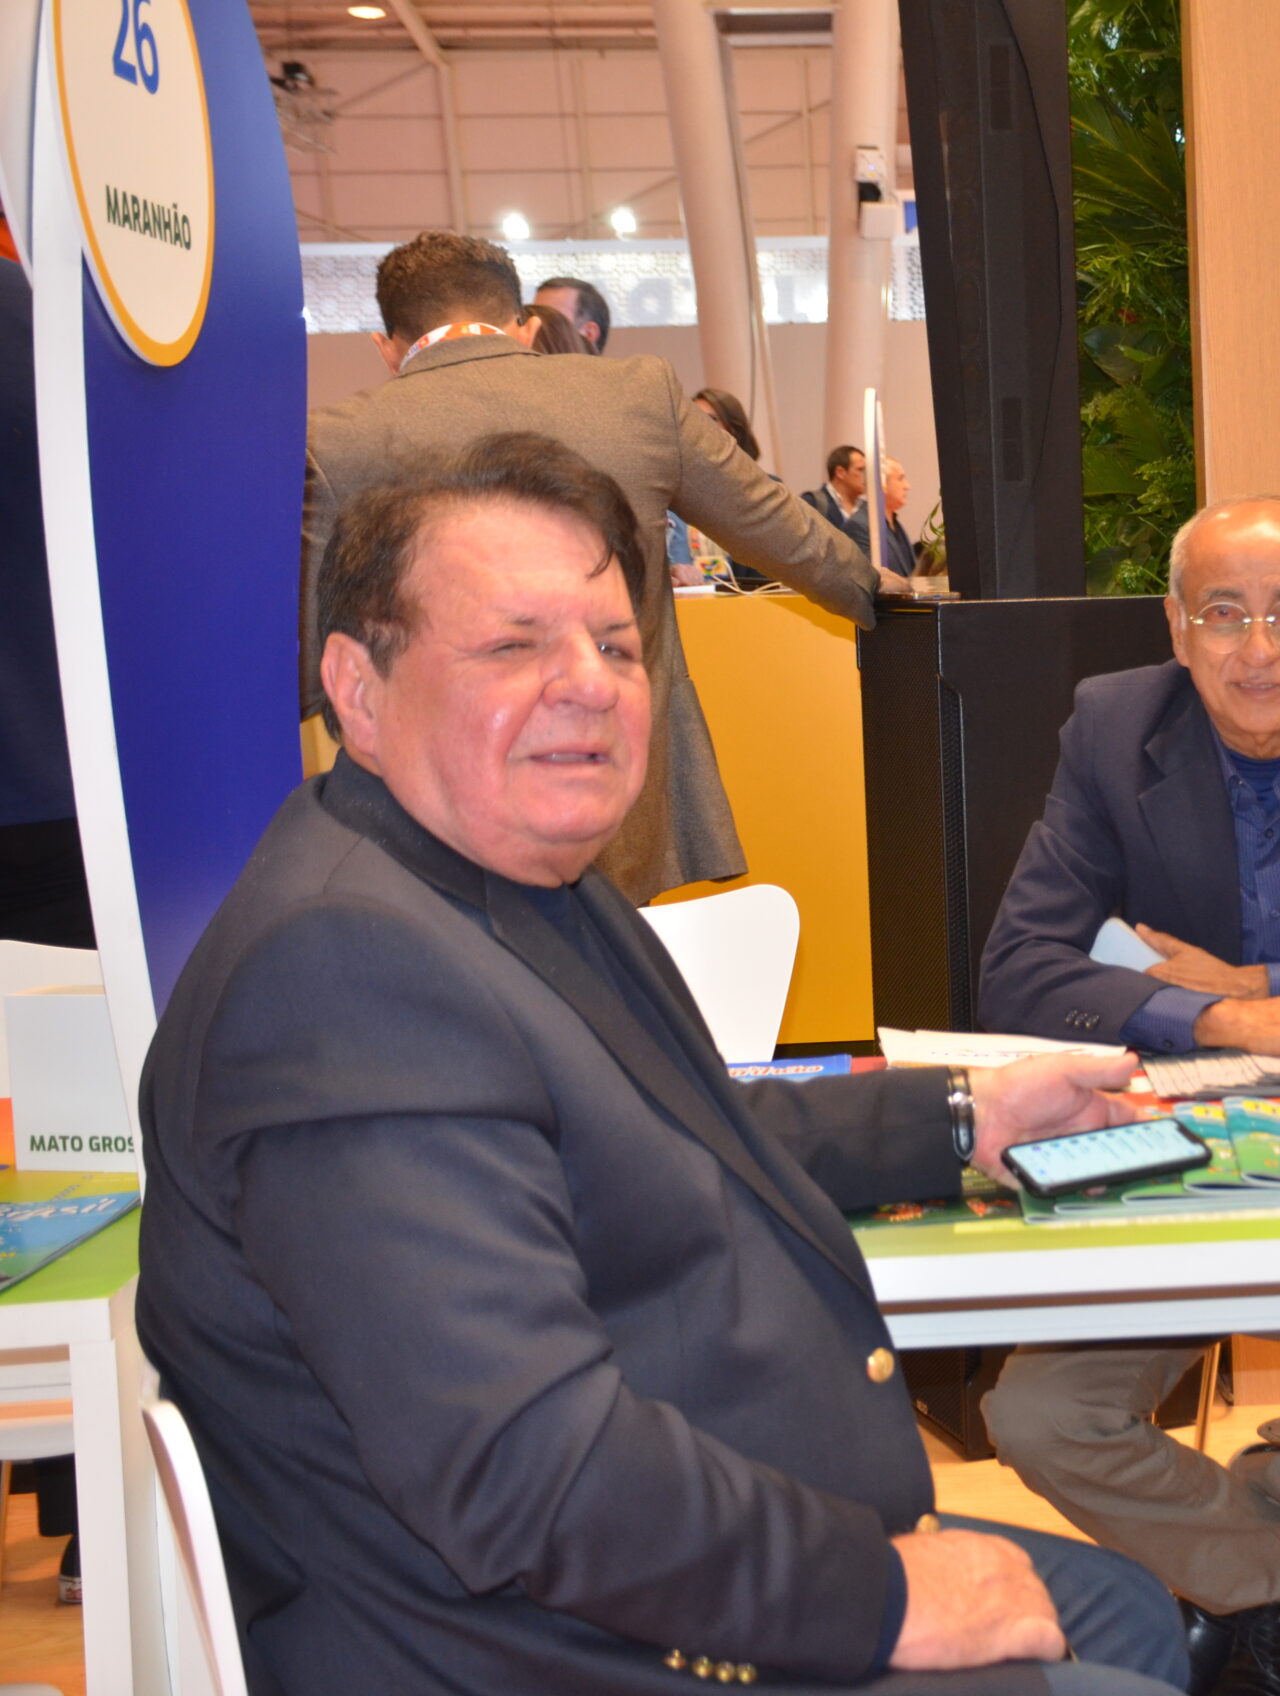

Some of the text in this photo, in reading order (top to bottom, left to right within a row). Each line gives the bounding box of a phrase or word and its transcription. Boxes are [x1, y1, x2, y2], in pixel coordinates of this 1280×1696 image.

[112, 0, 160, 94] 26
[105, 185, 192, 251] MARANHÃO
[29, 1134, 84, 1153] MATO
